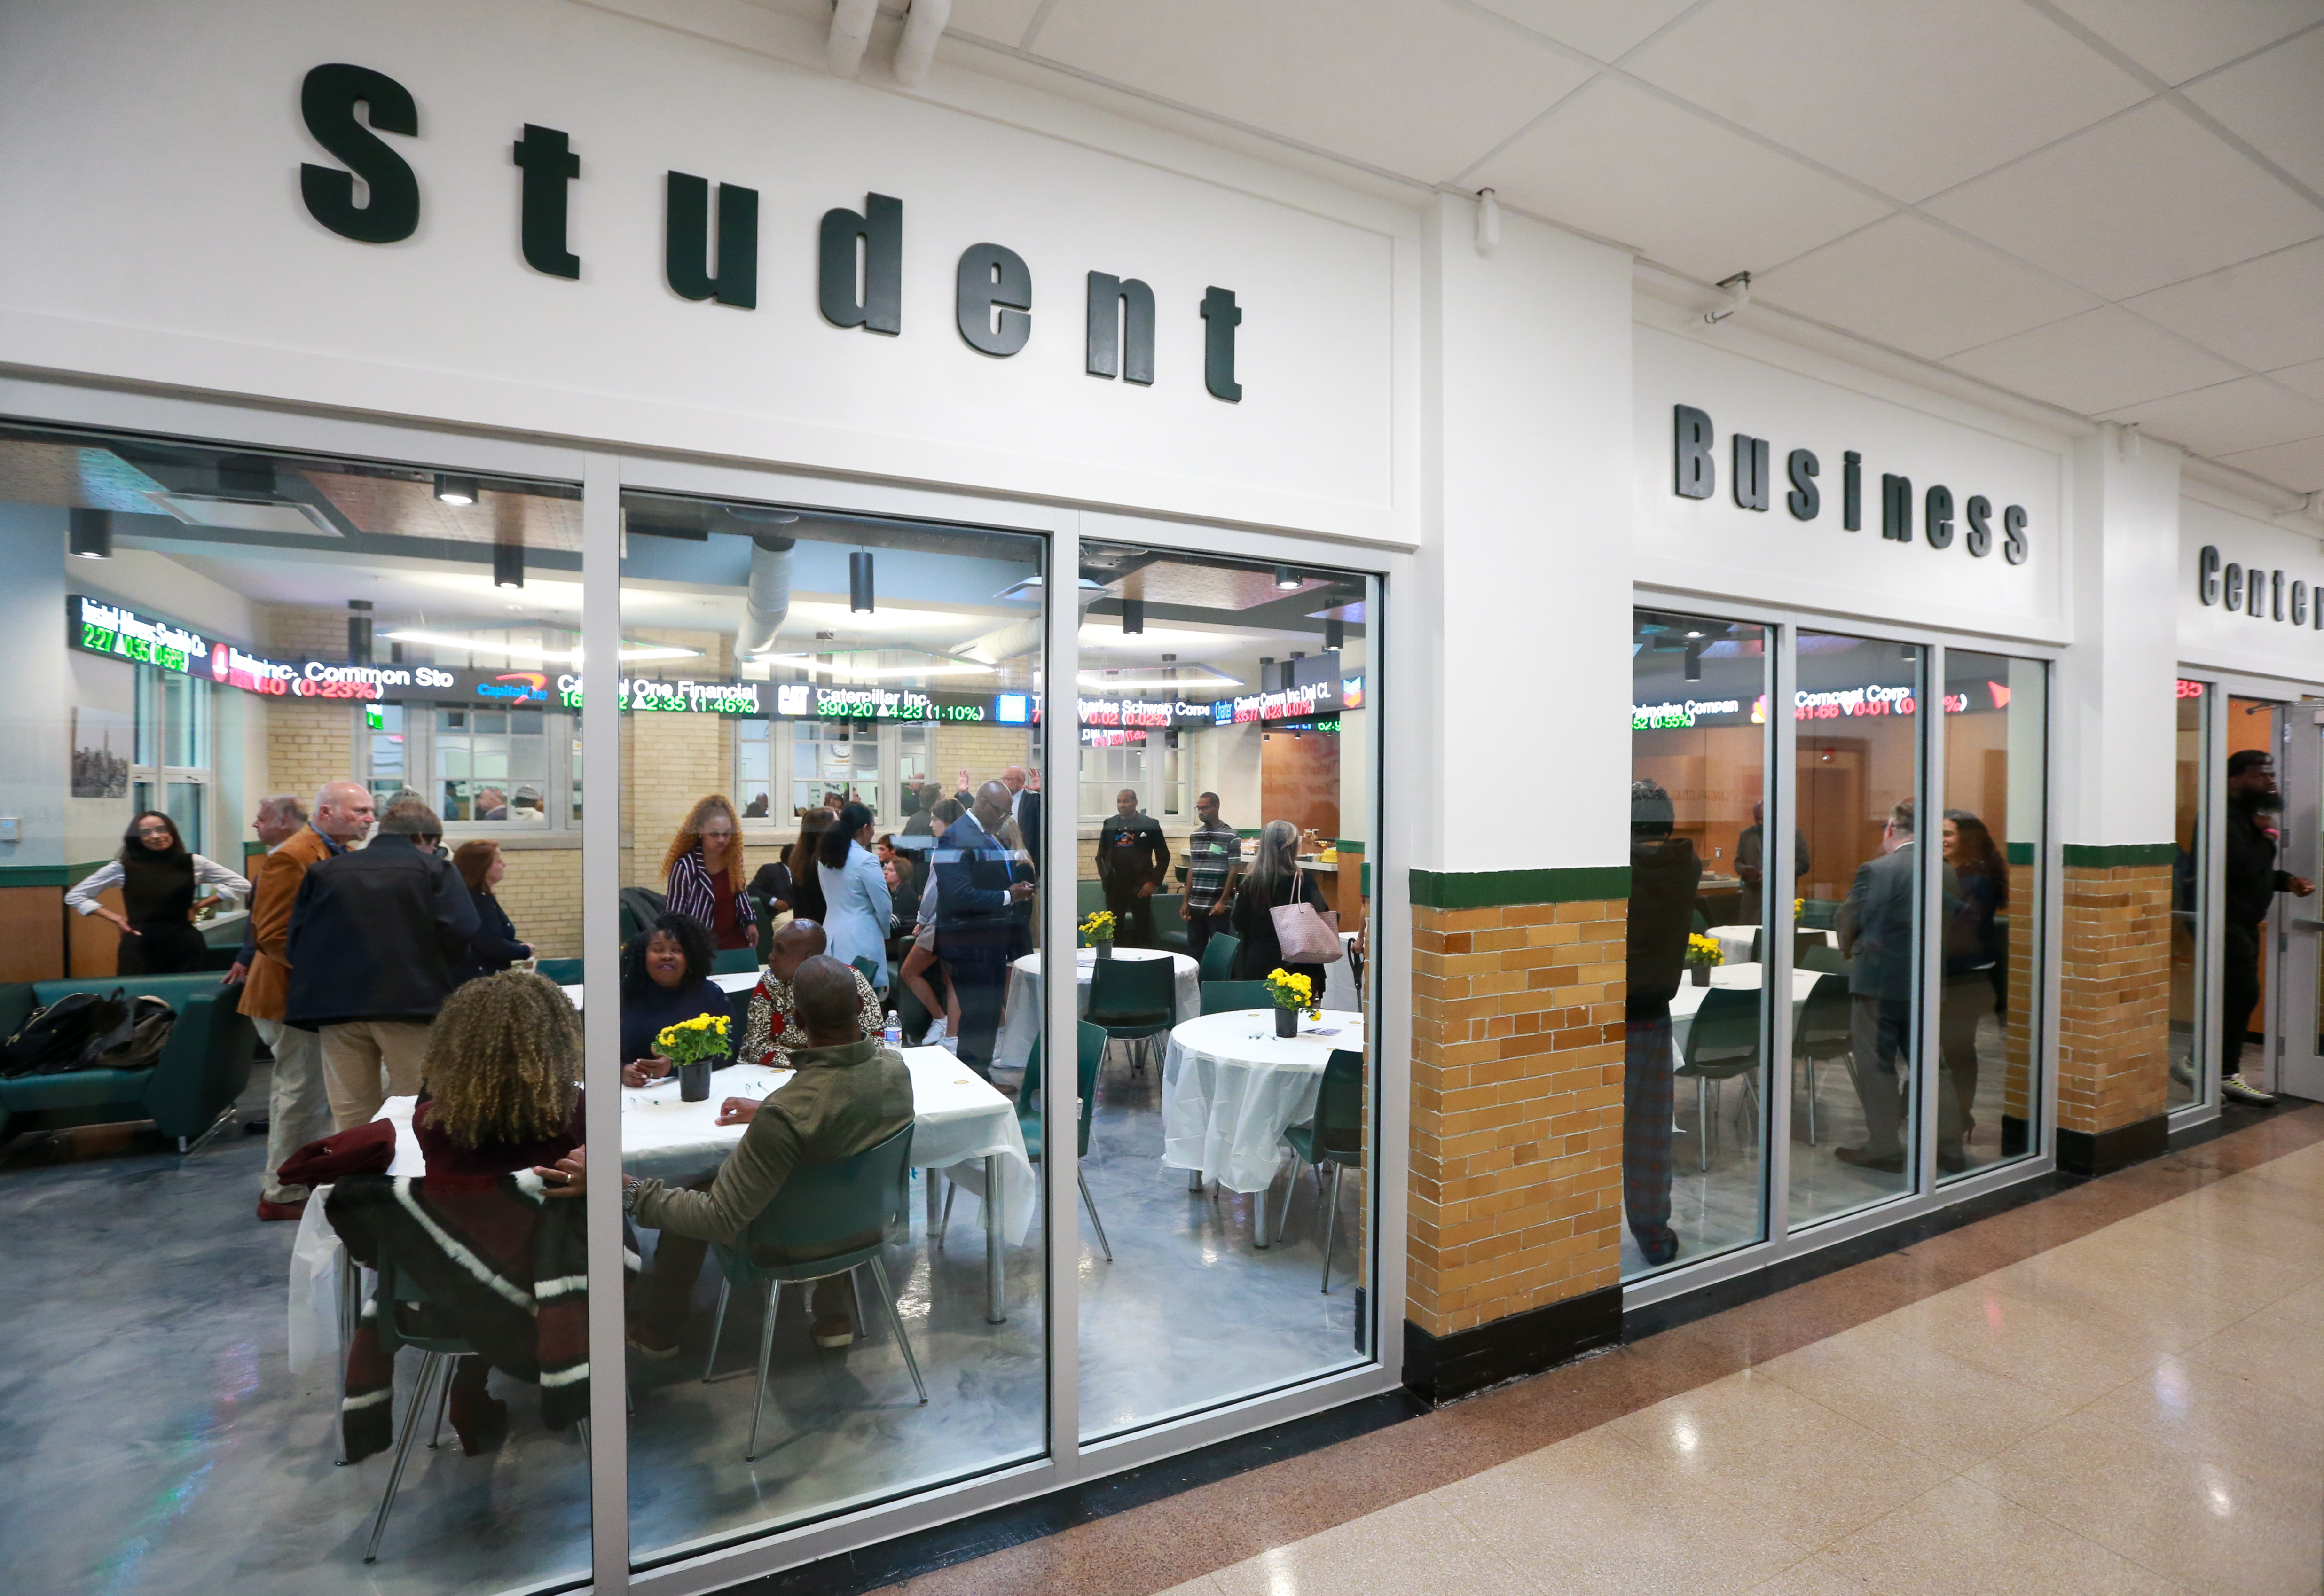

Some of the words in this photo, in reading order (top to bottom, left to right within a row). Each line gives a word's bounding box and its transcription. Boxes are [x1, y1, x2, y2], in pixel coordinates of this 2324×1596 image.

[300, 62, 1243, 403] Student
[1674, 403, 2028, 565] Business
[2200, 545, 2324, 630] Center
[305, 662, 410, 685] Common
[416, 667, 454, 687] Sto
[292, 677, 384, 699] (0.23%)
[633, 679, 673, 696] One
[678, 681, 757, 699] Financial
[817, 688, 901, 705] Caterpillar
[904, 690, 931, 706] Inc.
[1234, 696, 1260, 711] Charter
[1260, 692, 1286, 707] Comm
[1286, 688, 1300, 703] Inc
[1300, 684, 1316, 701] Del
[1794, 687, 1864, 707] Comcast
[646, 694, 687, 712] 2.35
[691, 696, 759, 714] (1.46%)
[817, 701, 873, 718] 390.20
[888, 704, 923, 719] 4.23
[926, 704, 984, 721] (1.10%)
[1077, 698, 1120, 713] harles
[1122, 700, 1173, 715] Schwab
[1234, 707, 1259, 723] 335.77
[1264, 704, 1282, 719] 0.23
[1685, 700, 1738, 714] Compan
[1794, 704, 1840, 721] 41.66
[1853, 700, 1891, 716] 0.01
[1089, 712, 1119, 725] 0.02
[1121, 712, 1171, 727] (0.02%)
[1650, 713, 1695, 729] (0.55%)
